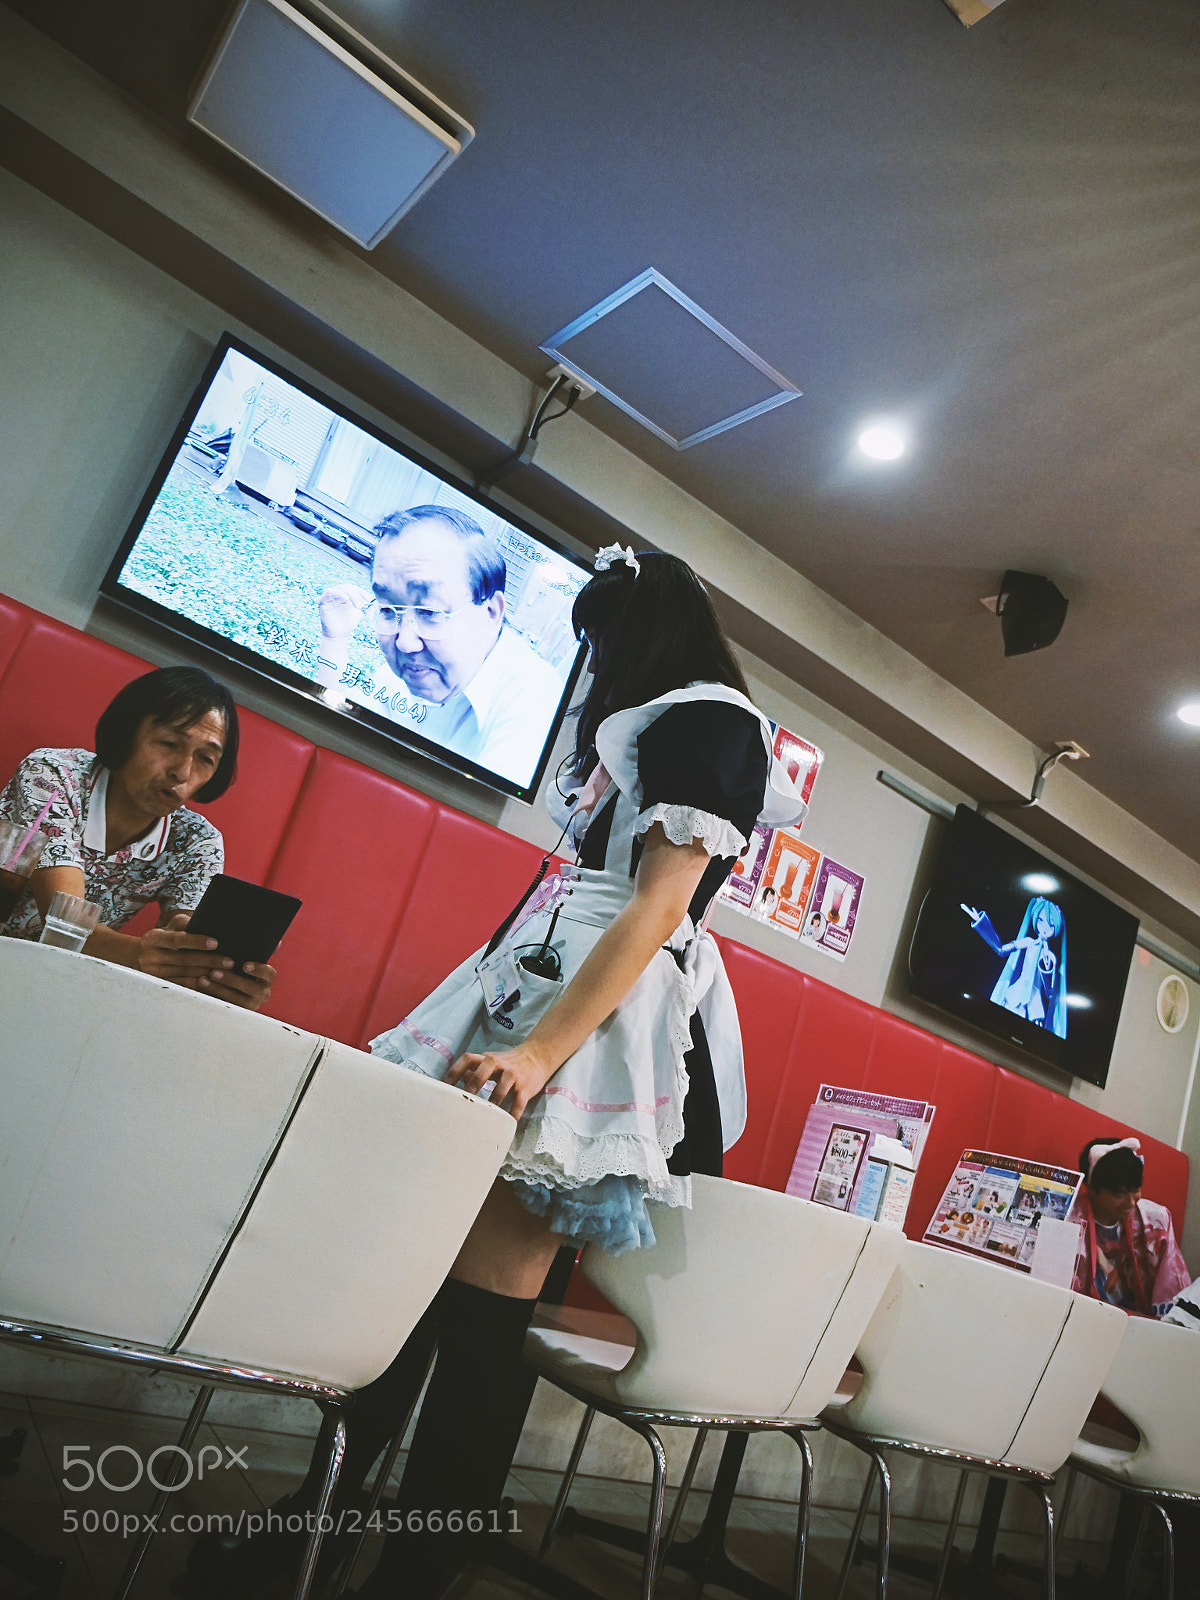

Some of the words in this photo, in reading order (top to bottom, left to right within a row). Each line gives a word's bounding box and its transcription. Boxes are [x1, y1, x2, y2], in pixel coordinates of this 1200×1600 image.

[243, 386, 291, 426] 6:34
[264, 624, 428, 724] 鈴木一男さん(64)
